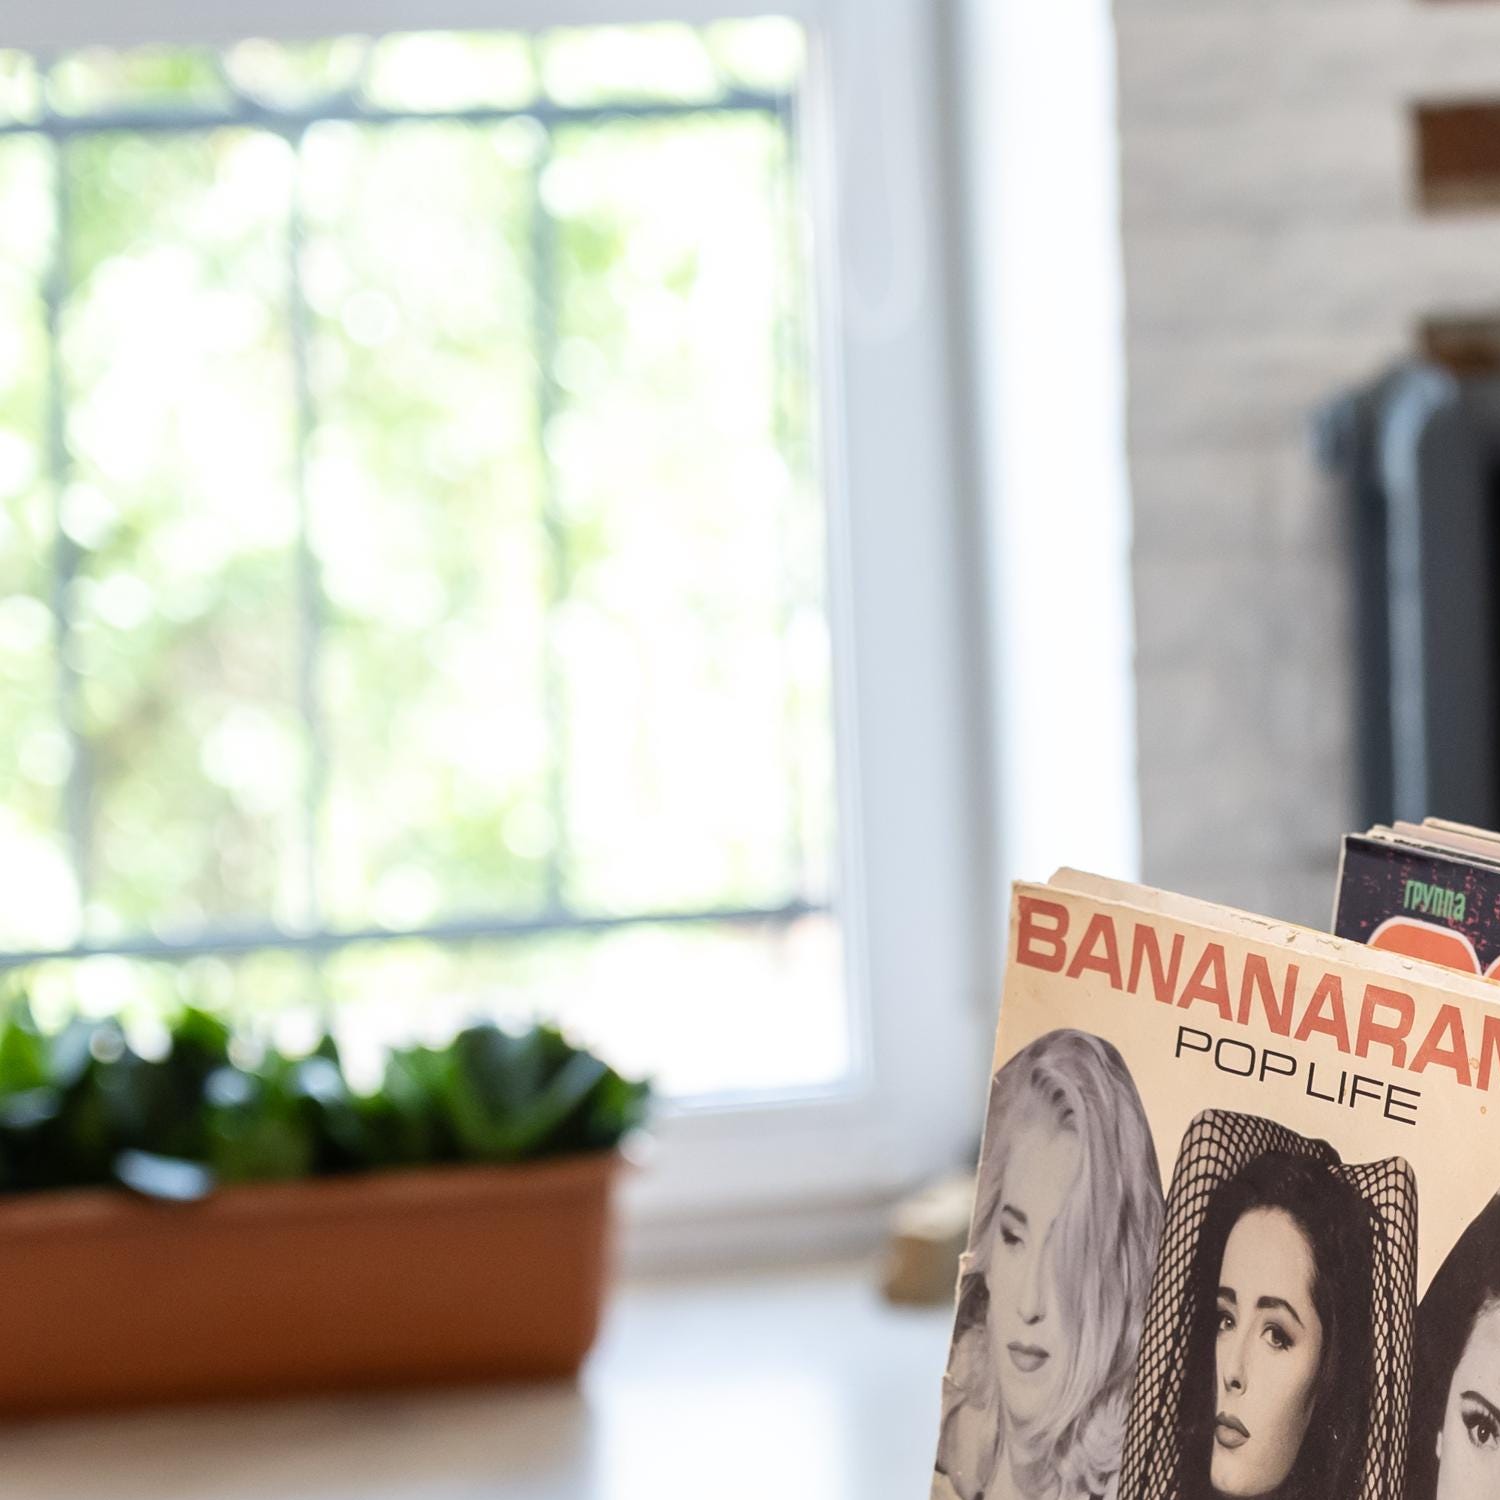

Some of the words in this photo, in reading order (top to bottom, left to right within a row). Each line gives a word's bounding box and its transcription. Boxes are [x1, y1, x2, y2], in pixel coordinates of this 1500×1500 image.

[1404, 880, 1466, 922] группа
[1174, 1026, 1298, 1083] POP
[1305, 1062, 1422, 1126] LIFE
